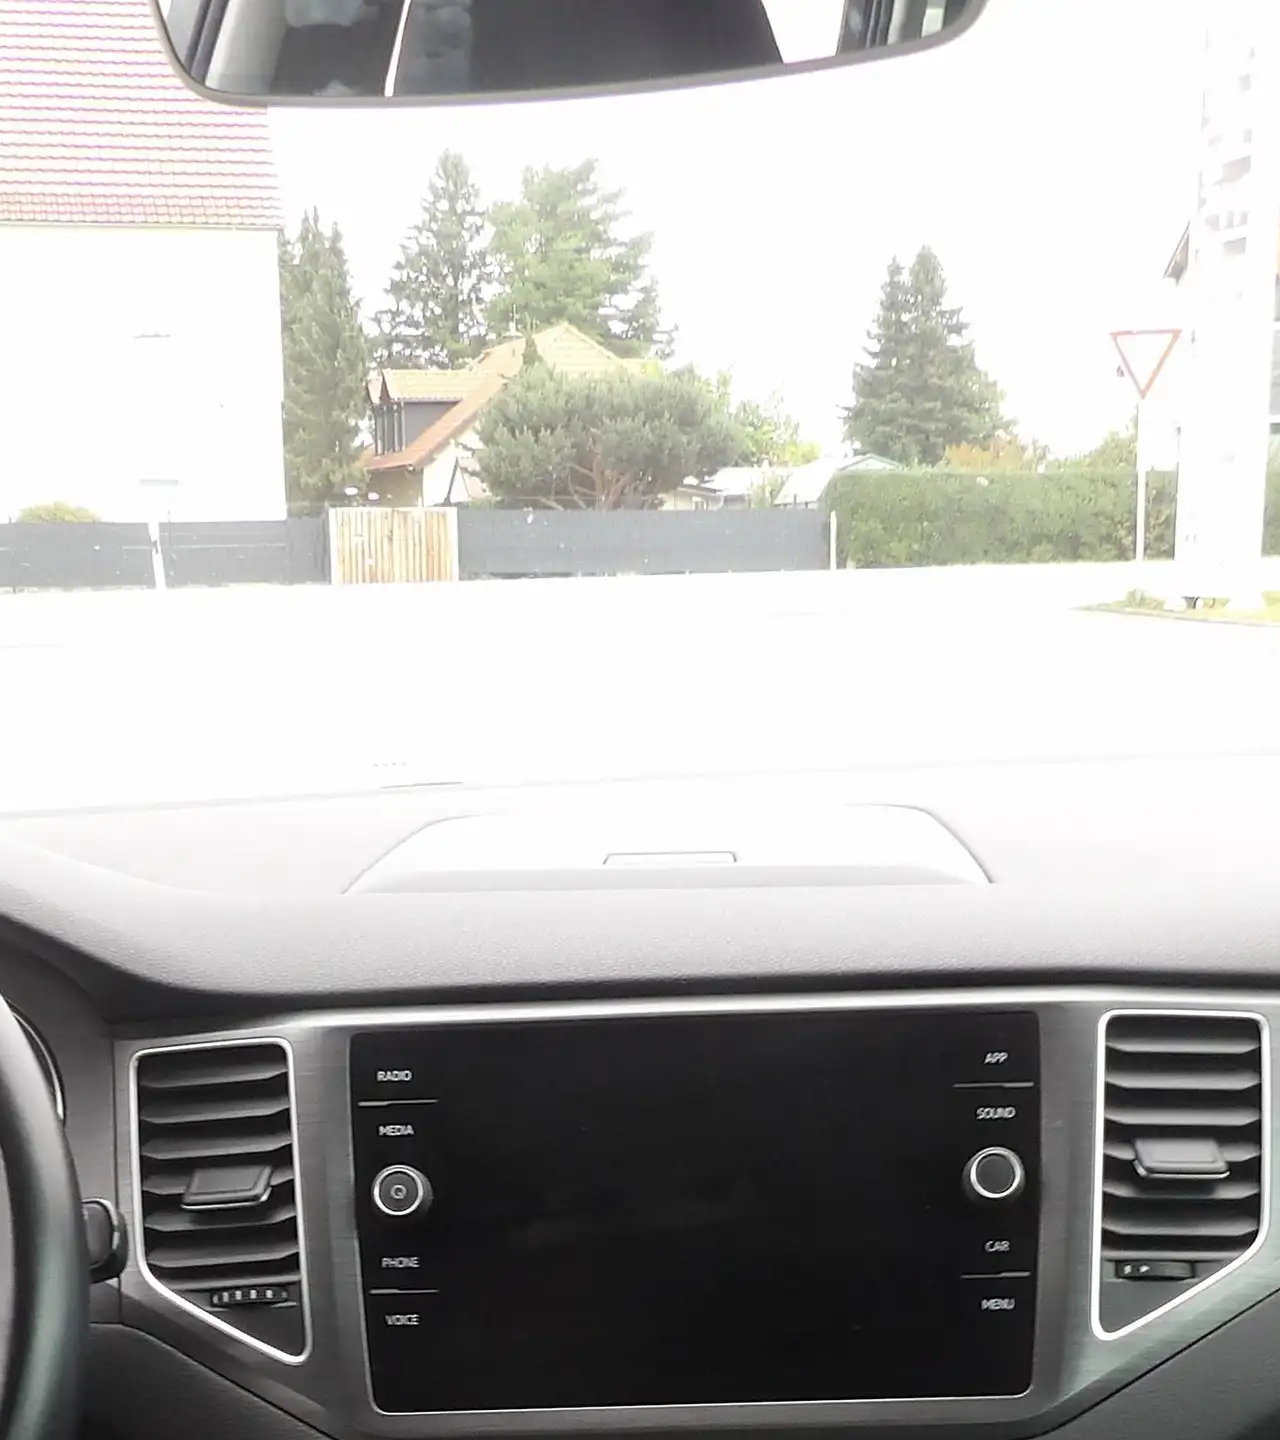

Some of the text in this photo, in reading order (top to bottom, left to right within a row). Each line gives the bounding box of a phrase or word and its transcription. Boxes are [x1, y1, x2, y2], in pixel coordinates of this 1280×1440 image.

[984, 1052, 1009, 1064] APP
[376, 1070, 413, 1082] RADIO
[976, 1107, 1017, 1120] SOUND
[378, 1125, 415, 1136] MEDIA
[984, 1240, 1010, 1252] CAR
[381, 1256, 420, 1268] PHONE
[981, 1298, 1015, 1311] MENU
[385, 1313, 420, 1326] VOICE
